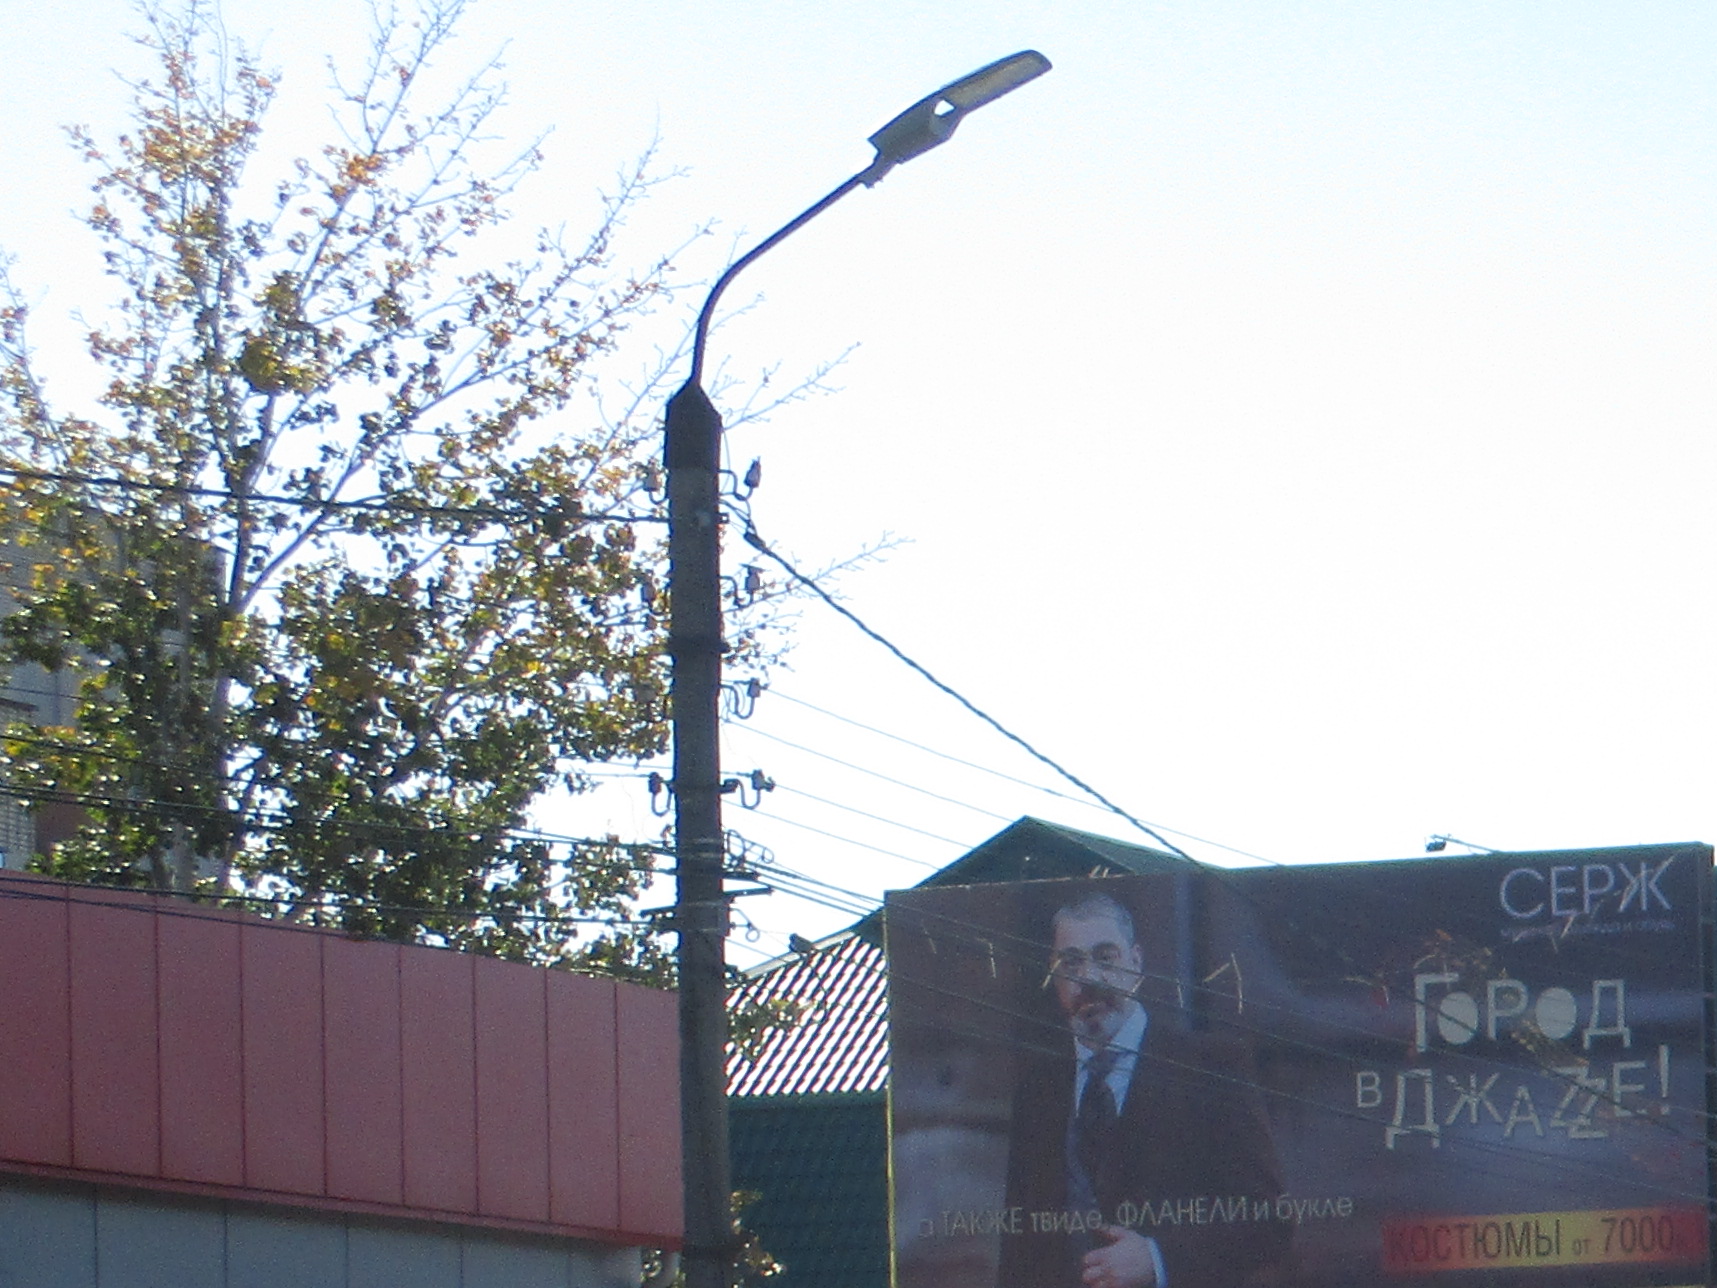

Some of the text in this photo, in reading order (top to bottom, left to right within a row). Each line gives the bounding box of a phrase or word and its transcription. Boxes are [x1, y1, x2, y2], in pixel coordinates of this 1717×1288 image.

[1500, 858, 1671, 919] СЕРЖ
[1413, 972, 1632, 1053] ГОРОД
[941, 1207, 1023, 1237] ТАКЖЕ
[1117, 1196, 1248, 1228] ФЛАНЕЛИ
[1254, 1203, 1270, 1221] и
[1276, 1193, 1353, 1225] букле
[1387, 1219, 1561, 1263] КОСТЮМЫ
[1600, 1214, 1674, 1253] 7000
